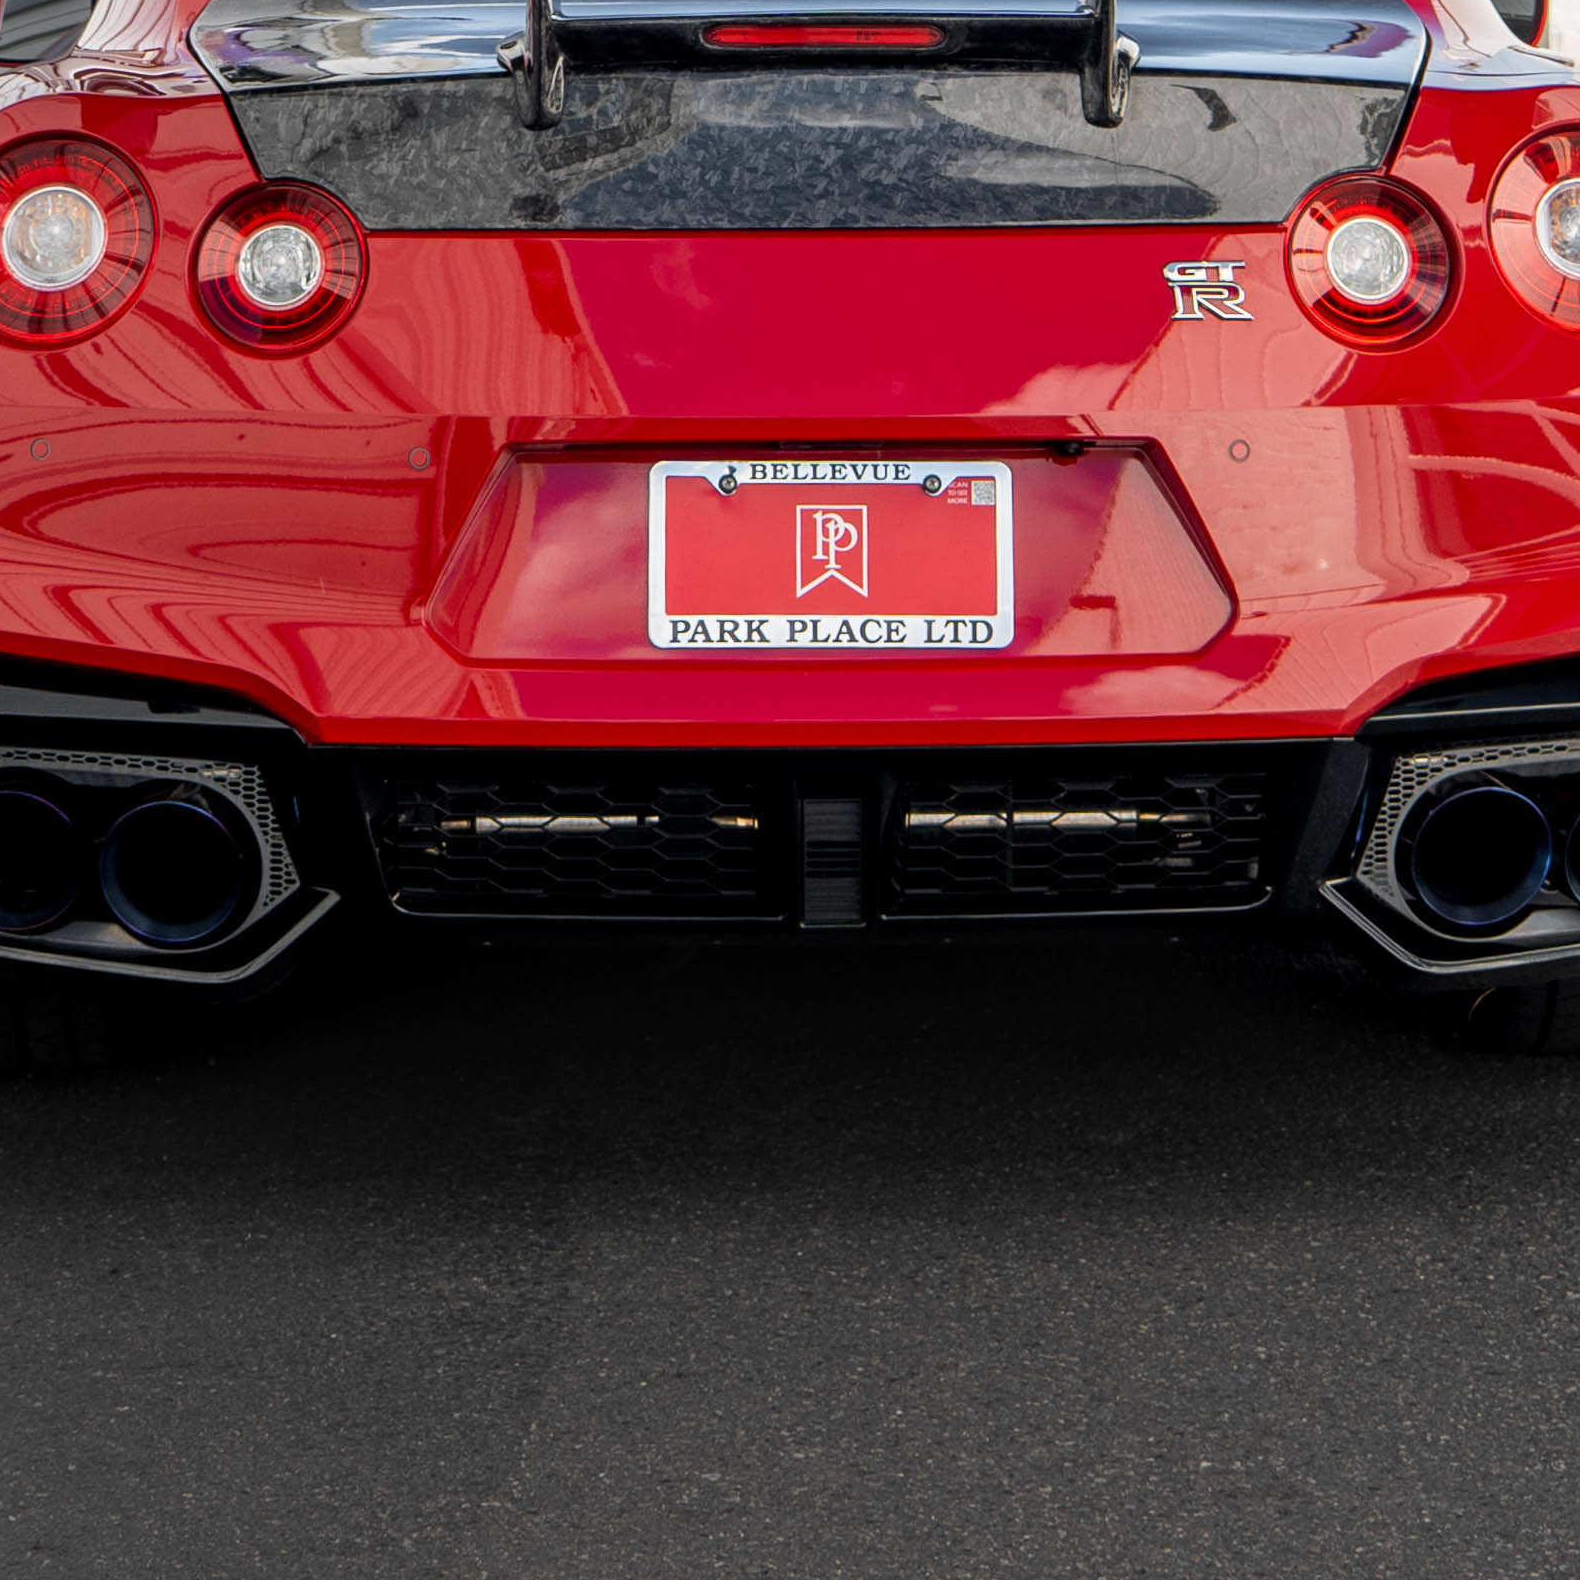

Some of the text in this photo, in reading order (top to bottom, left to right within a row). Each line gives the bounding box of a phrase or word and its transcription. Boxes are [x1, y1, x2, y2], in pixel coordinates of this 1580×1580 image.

[1162, 260, 1246, 282] GT
[1167, 281, 1255, 321] R
[749, 463, 912, 481] BELLEVUE
[947, 497, 968, 505] MORE
[668, 618, 994, 644] PARK PLACE LTD
